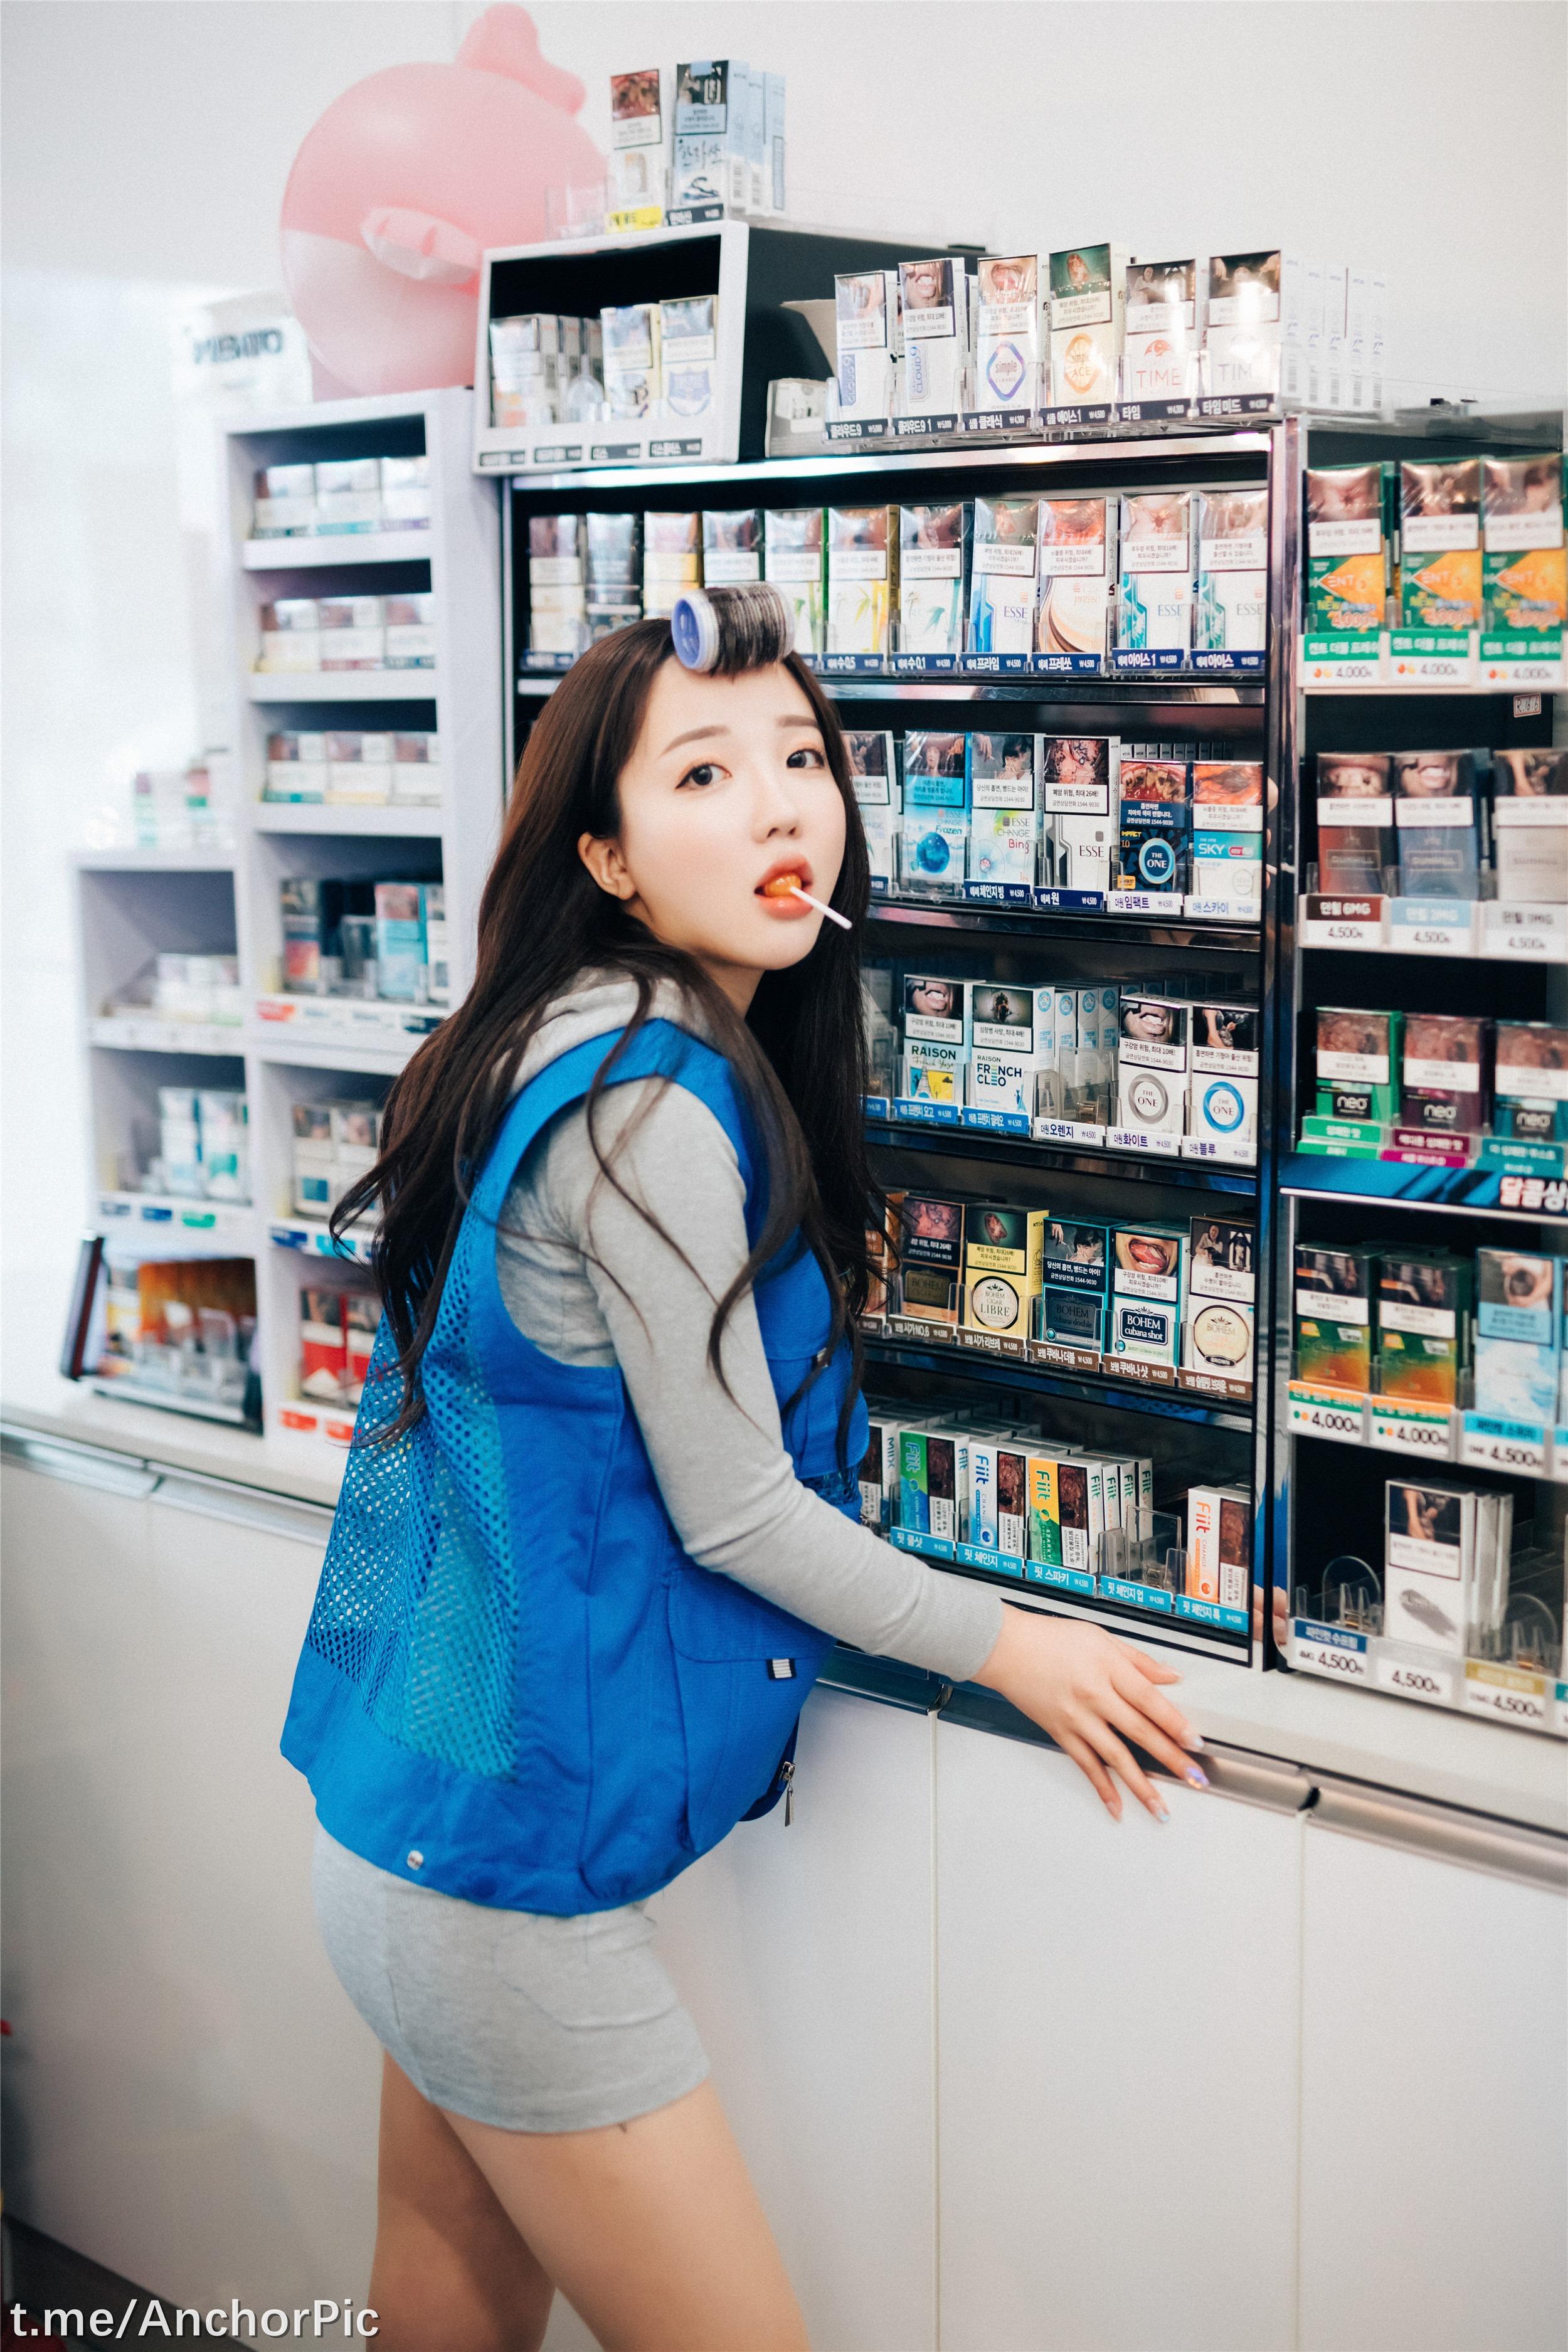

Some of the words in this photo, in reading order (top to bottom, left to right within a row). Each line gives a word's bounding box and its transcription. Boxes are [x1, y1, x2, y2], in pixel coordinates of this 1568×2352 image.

[909, 346, 923, 394] CLOUD9
[995, 361, 1017, 376] simple
[1073, 366, 1091, 378] ACE
[1136, 368, 1182, 388] TIME
[1122, 405, 1141, 420] 타임
[979, 414, 1003, 430] 클래식
[1004, 606, 1028, 618] ESSE
[1158, 604, 1183, 617] ESSE
[1237, 603, 1266, 616] ESSE
[977, 657, 999, 670] 프라임
[1017, 785, 1029, 793] 아이!
[1063, 789, 1074, 797] 위험,
[1012, 817, 1030, 827] ESSE
[935, 824, 962, 835] Frozen
[997, 828, 1030, 837] CHANGE
[1009, 839, 1029, 854] Bing
[1079, 845, 1104, 857] ESSE
[1198, 842, 1225, 855] SKY
[1147, 859, 1167, 869] ONE
[1009, 889, 1024, 898] ₩4,500
[1051, 892, 1060, 905] 원
[1082, 896, 1097, 905] ₩4,500
[1125, 896, 1150, 909] 임팩트
[1158, 899, 1173, 908] ₩4,500
[911, 1045, 956, 1060] RAISON
[1124, 1042, 1138, 1050] 구강암
[1139, 1044, 1151, 1053] 위험,
[1152, 1046, 1161, 1054] 최대
[1162, 1047, 1175, 1056] 10배!
[1150, 1057, 1173, 1066] 1544-9030
[977, 1062, 1022, 1078] FRENCH
[977, 1074, 1006, 1087] CLEO
[1137, 1096, 1158, 1108] ONE
[1337, 1096, 1367, 1110] neo
[1213, 1105, 1234, 1116] ONE
[1424, 1104, 1457, 1119] neo
[1007, 1119, 1022, 1127] ₩4,500
[1516, 1112, 1551, 1127] neo
[1041, 1125, 1049, 1135] 더원
[1050, 1123, 1074, 1139] 오렌지
[1081, 1130, 1096, 1139] ₩4,500
[1114, 1133, 1123, 1145] 더원
[1123, 1133, 1148, 1147] 화이트
[1156, 1140, 1171, 1149] ₩4,500
[1500, 1176, 1568, 1211] 달콤상
[1047, 1261, 1061, 1270] 당신의
[1062, 1263, 1073, 1273] 흡연,
[1074, 1265, 1088, 1274] 병드는
[1089, 1268, 1101, 1276] 아이!
[1051, 1272, 1074, 1282] 금연상담전화
[1075, 1277, 1097, 1286] 1544-9030
[1129, 1279, 1162, 1290] 피우시겠습니까?
[985, 1290, 1005, 1300] BOHEM
[980, 1303, 1010, 1317] LIBRE
[1056, 1303, 1089, 1318] BOHEM
[1072, 1318, 1092, 1328] double
[1126, 1315, 1160, 1330] BOHEM
[1207, 1323, 1236, 1336] BOHEM
[1125, 1327, 1147, 1338] cubana
[1148, 1329, 1163, 1341] shot
[1037, 1347, 1047, 1358] 보헴
[1078, 1355, 1093, 1365] ₩4,500
[1110, 1361, 1120, 1372] 보헴
[1152, 1369, 1168, 1379] ₩4,500
[905, 1441, 921, 1473] Fiit
[958, 1448, 968, 1470] Fiit
[975, 1454, 989, 1485] Fiit
[1036, 1470, 1051, 1501] Fiit
[1091, 1475, 1100, 1499] Fiit
[1106, 1476, 1116, 1501] Fiit
[1124, 1474, 1133, 1498] Fiit
[1142, 1470, 1151, 1493] Fiit
[1196, 1501, 1210, 1534] Fiit
[964, 1549, 973, 1561] 핏
[974, 1552, 998, 1568] 체인지
[1003, 1561, 1017, 1570] ₩4,500
[1034, 1566, 1043, 1579] 핏
[1045, 1569, 1069, 1586] 스파키
[1074, 1579, 1088, 1587] ₩4,500
[1108, 1582, 1115, 1595] 핏
[1116, 1585, 1136, 1601] 체인지
[1136, 1589, 1143, 1602] 업
